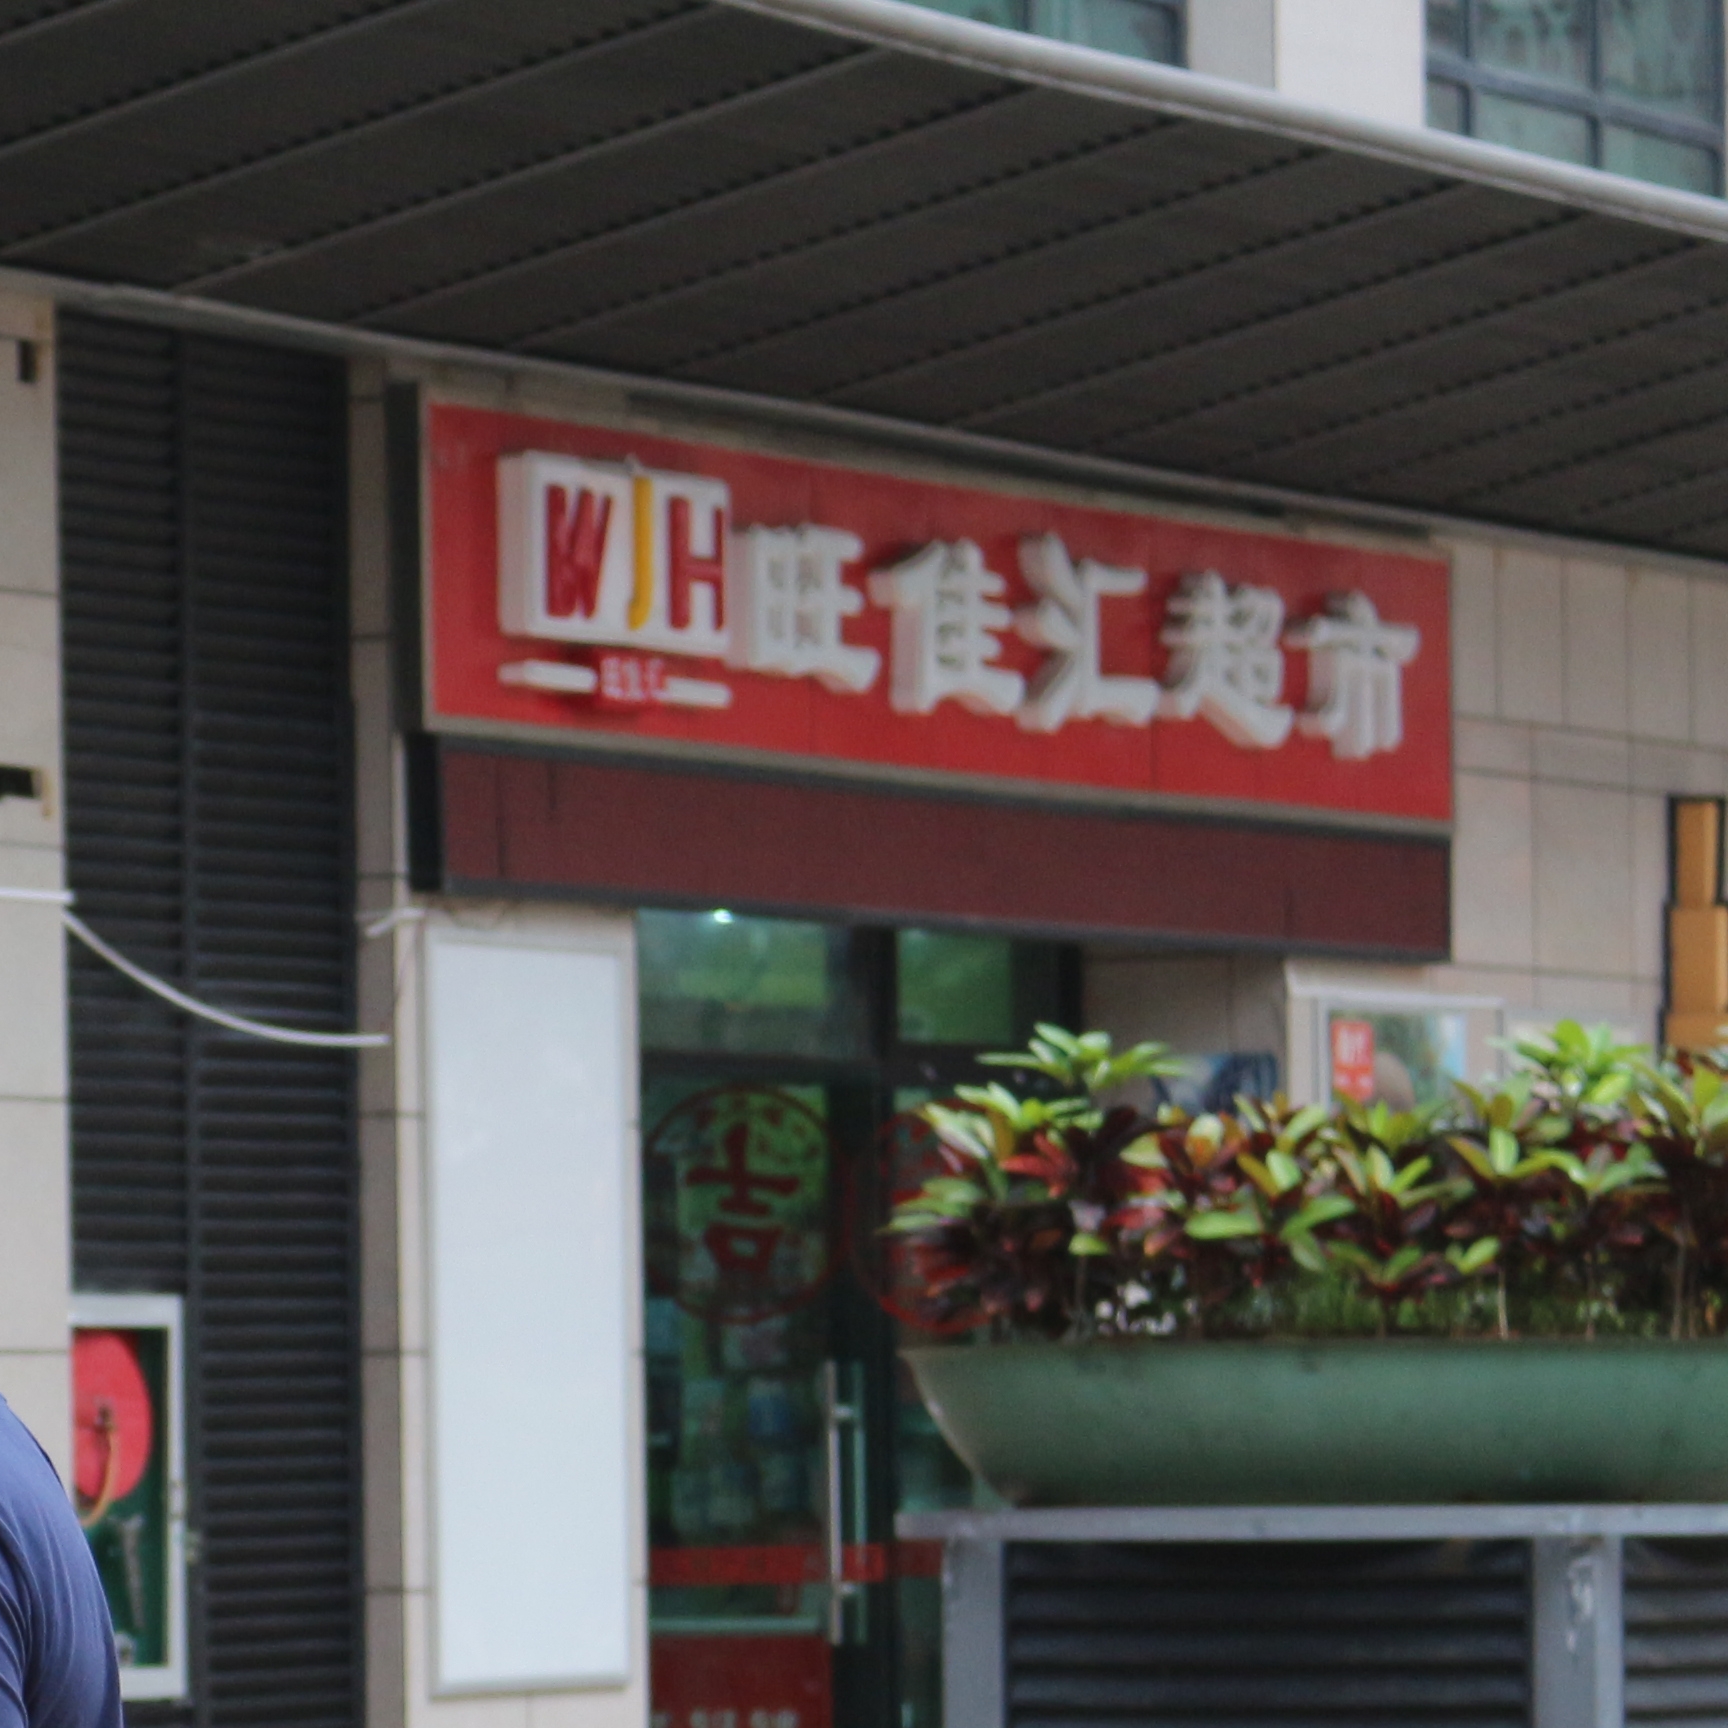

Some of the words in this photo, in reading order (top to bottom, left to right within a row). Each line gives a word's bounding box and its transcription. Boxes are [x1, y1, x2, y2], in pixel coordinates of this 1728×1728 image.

[545, 474, 725, 632] WJH
[732, 523, 1419, 760] 旺佳汇超市
